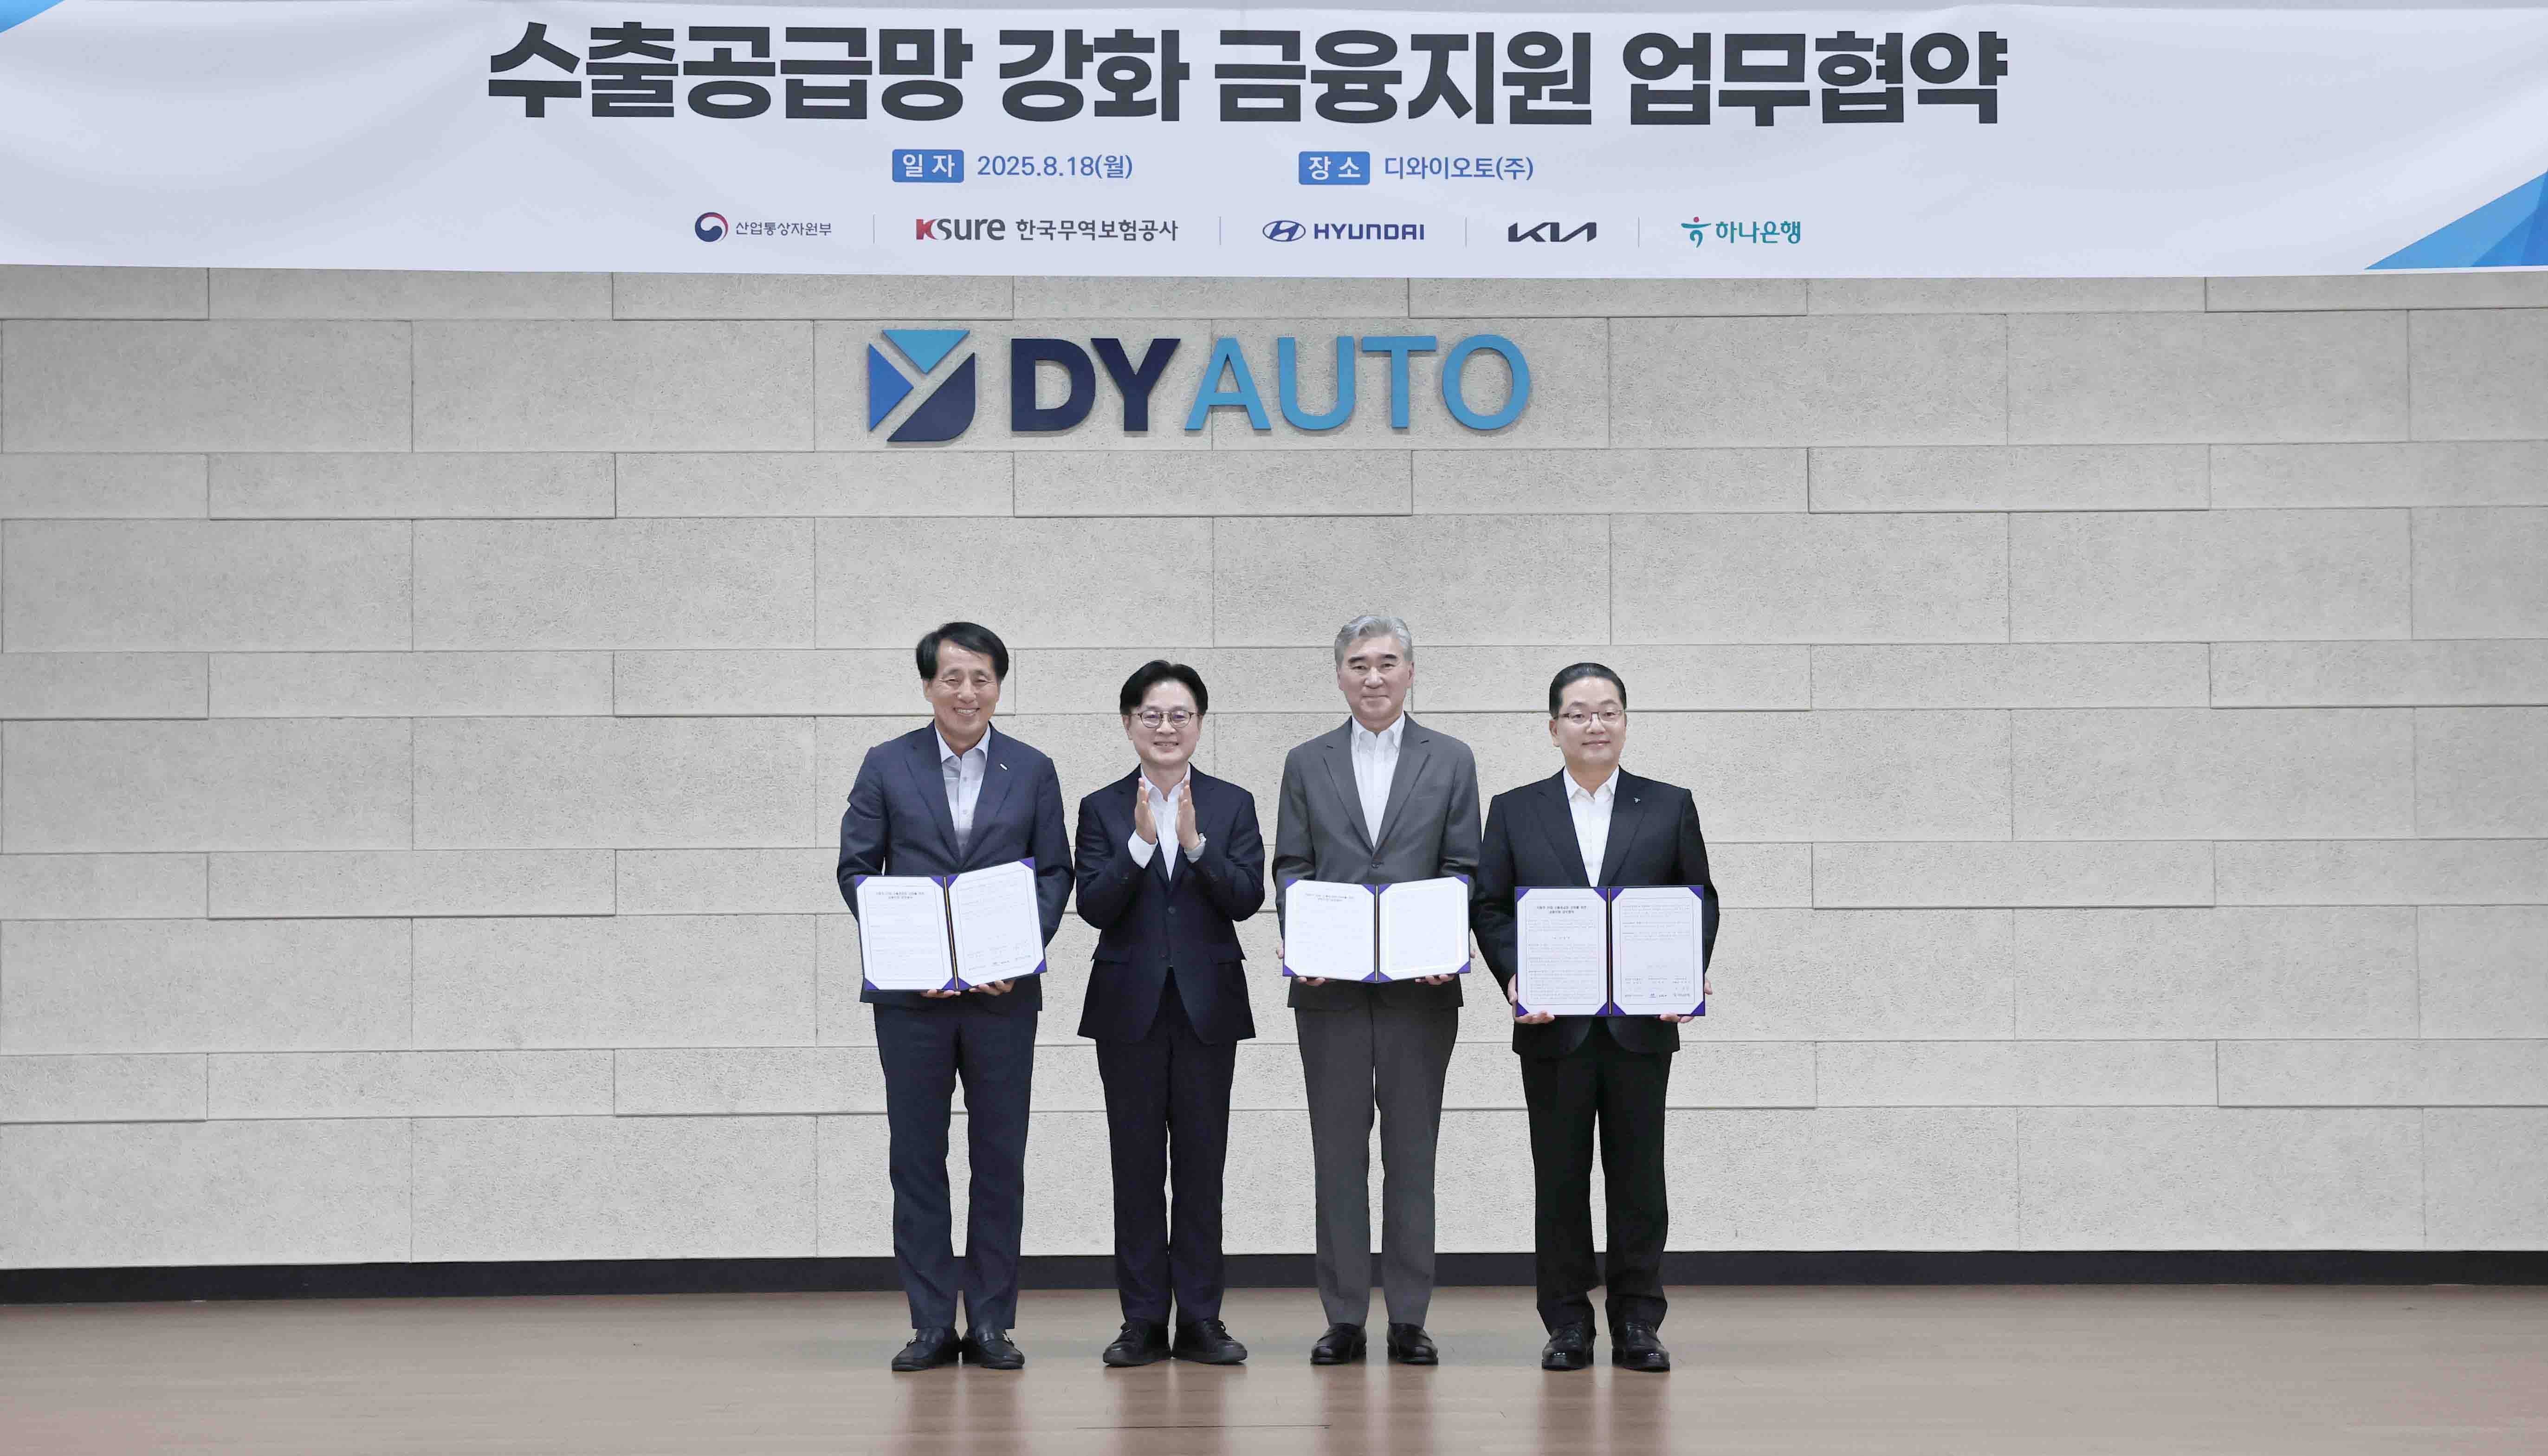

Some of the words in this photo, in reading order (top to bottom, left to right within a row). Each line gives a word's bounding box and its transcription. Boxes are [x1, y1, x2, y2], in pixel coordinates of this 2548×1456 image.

[488, 21, 974, 121] 수출공급망
[999, 29, 1191, 122] 강화
[1215, 30, 1592, 125] 금융지원
[1623, 30, 2008, 127] 업무협약
[977, 155, 1133, 180] 2025.8.18(월)
[1385, 157, 1534, 181] 디와이오토(주)
[736, 222, 832, 237] 산업통상자원부
[1015, 219, 1179, 242] 한국무역보험공사
[1314, 224, 1425, 241] HYUNDAI
[1715, 221, 1801, 245] 하나은행
